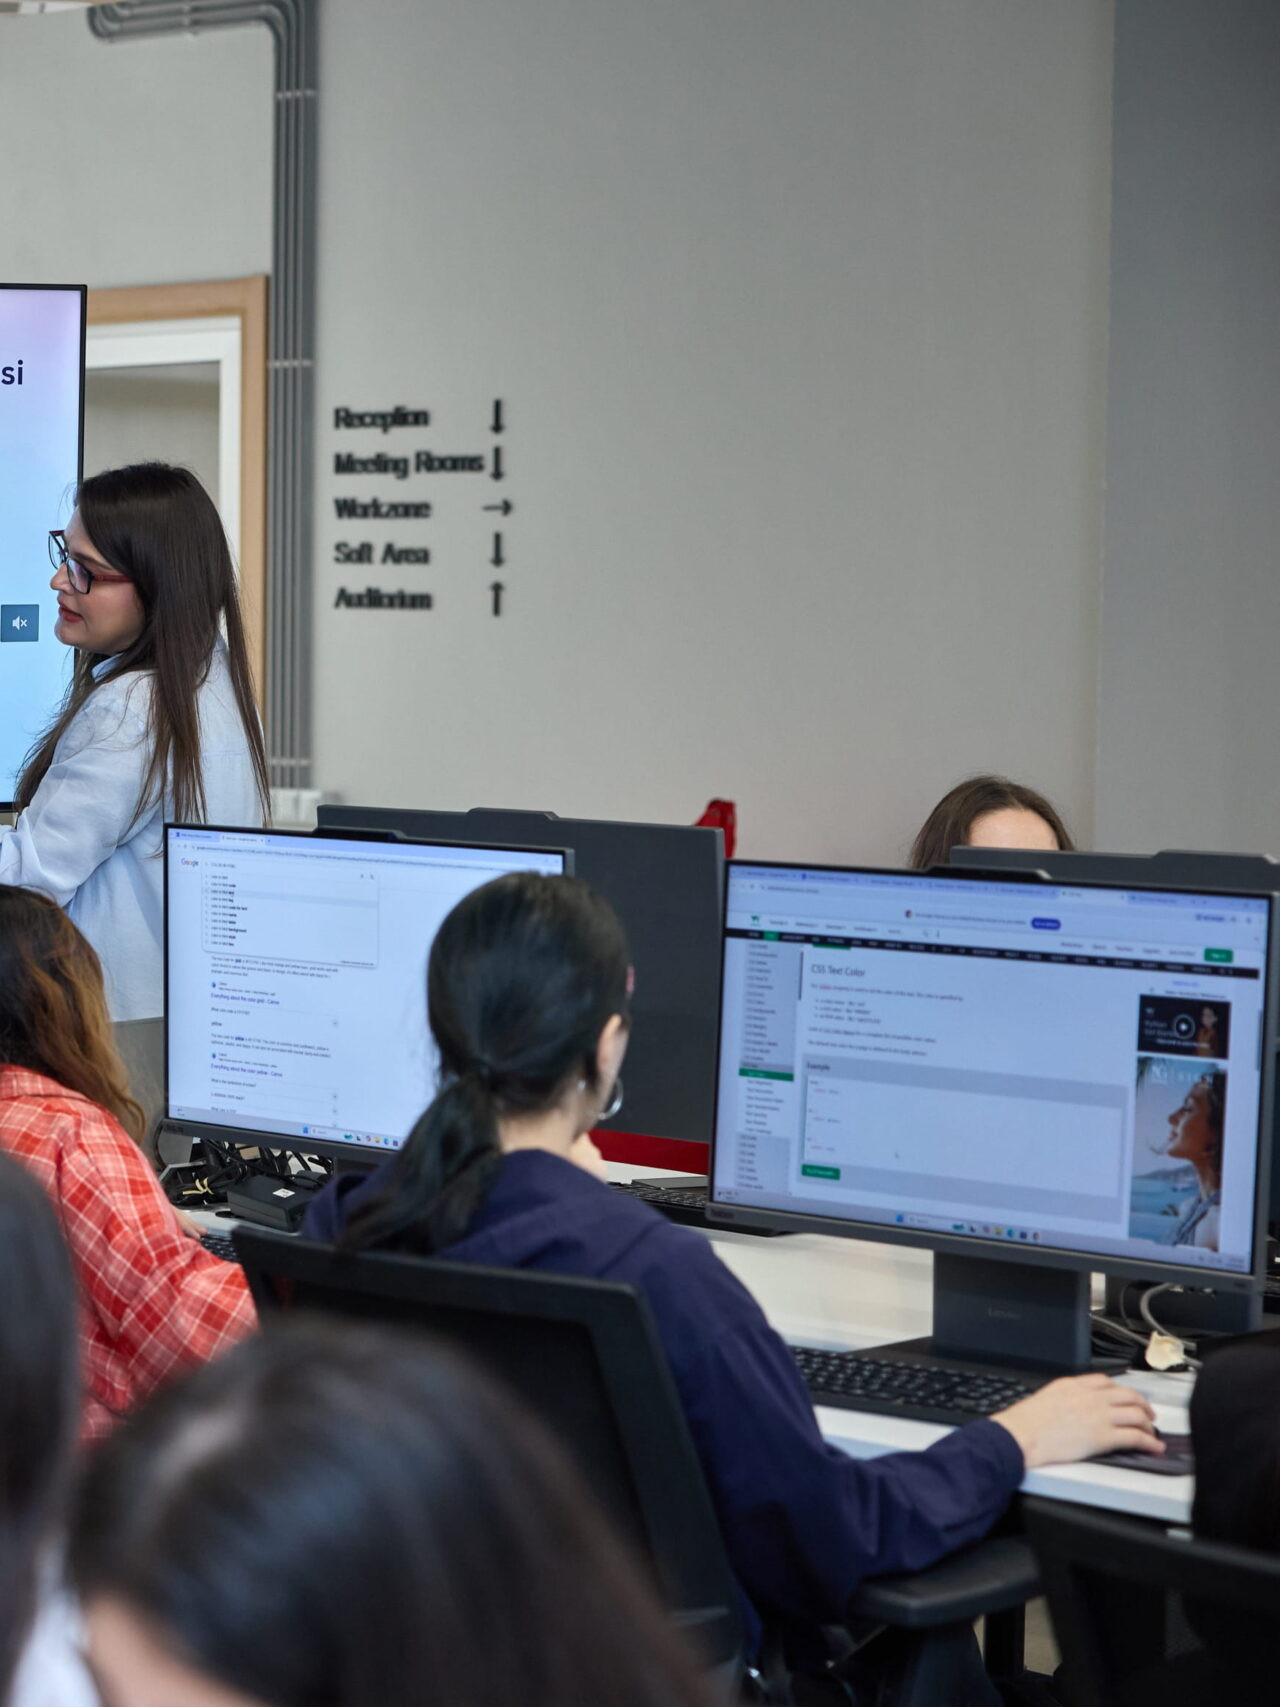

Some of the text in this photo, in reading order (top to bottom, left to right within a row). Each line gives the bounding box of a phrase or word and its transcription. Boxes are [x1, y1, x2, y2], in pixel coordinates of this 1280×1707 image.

[334, 406, 430, 434] Reception
[334, 450, 486, 480] Meeting Rooms
[334, 497, 432, 520] Workzone
[334, 542, 430, 565] Soft Area
[334, 587, 433, 611] Auditorium
